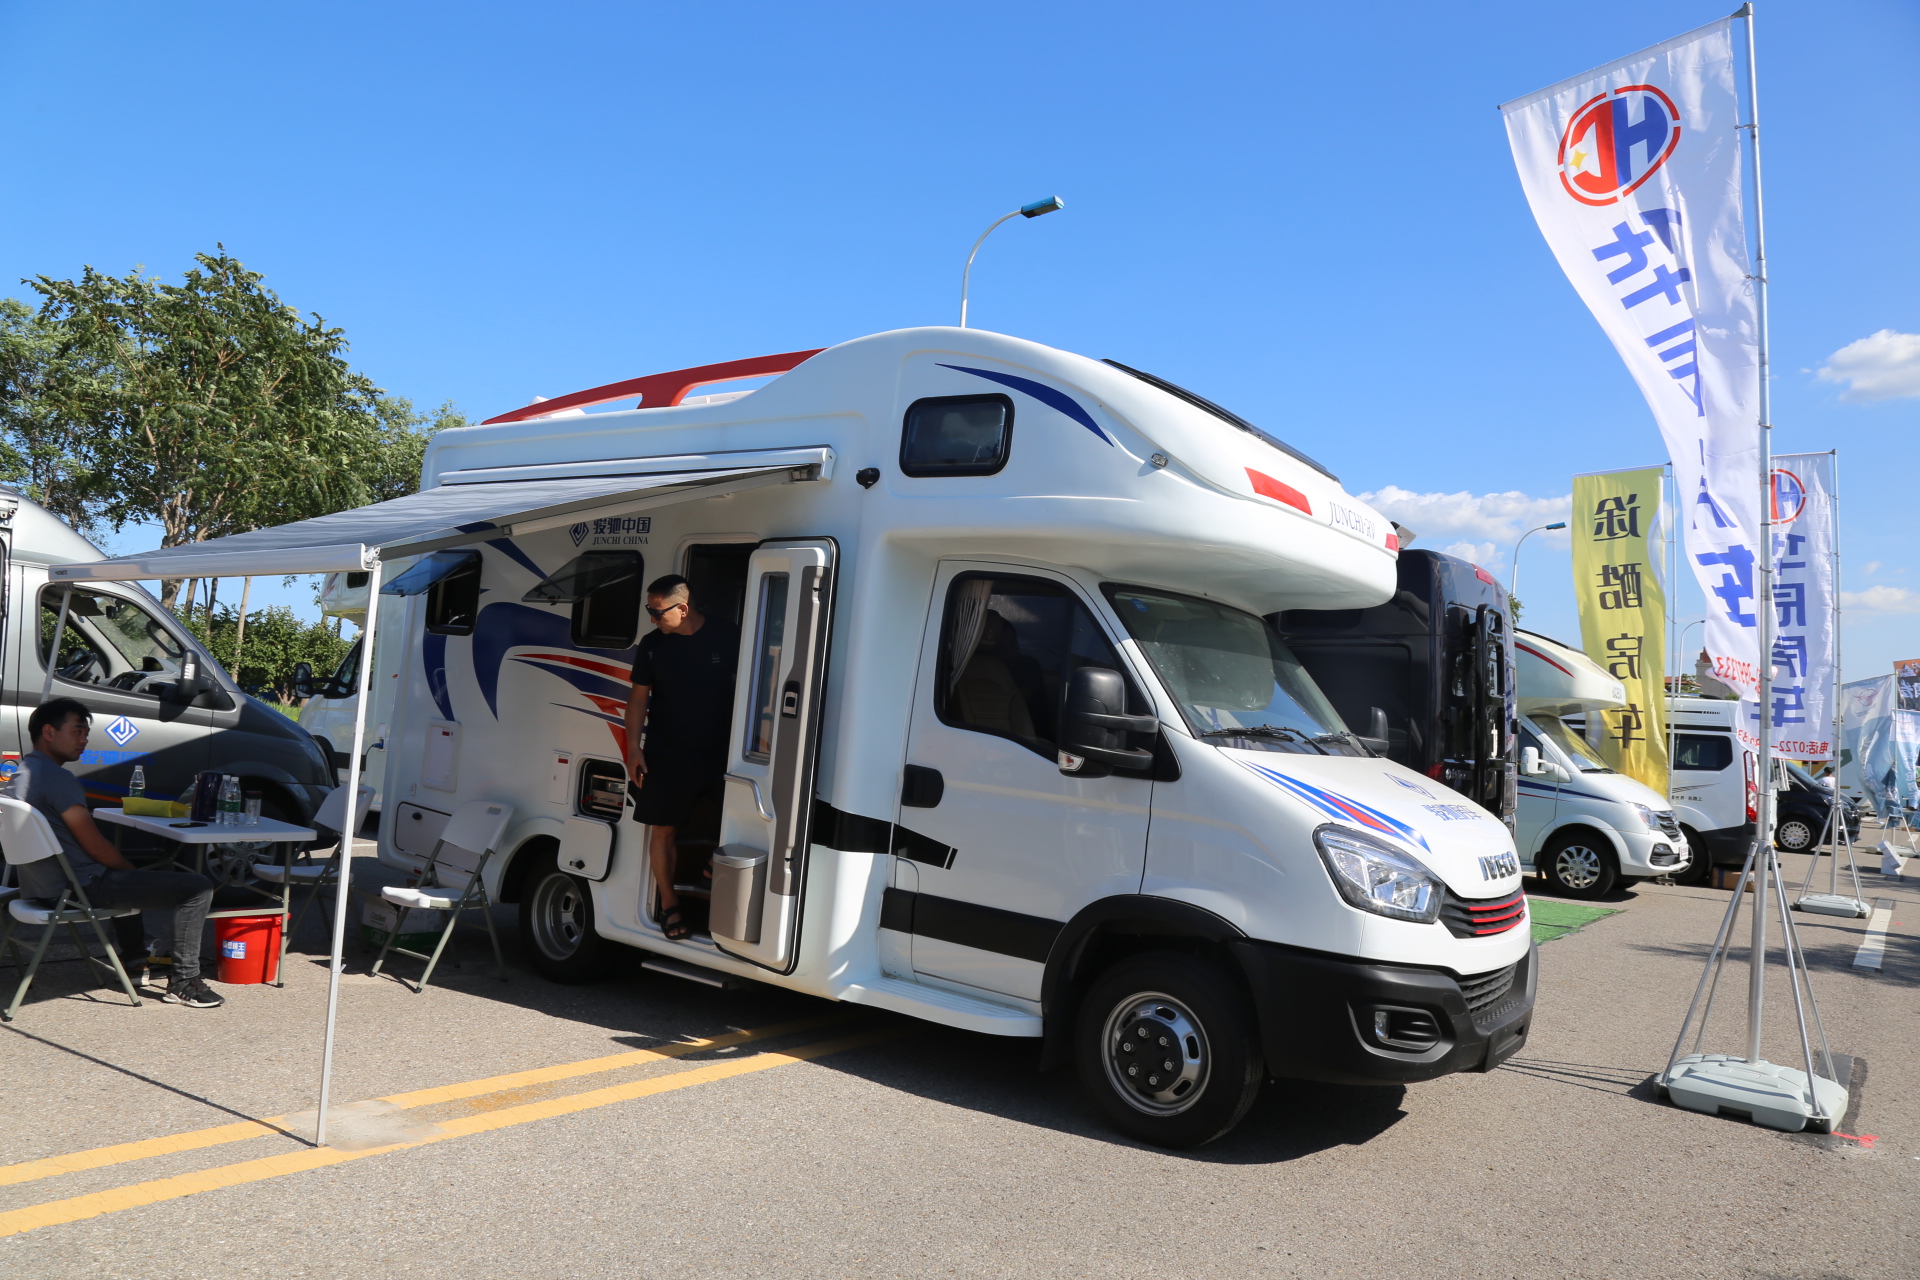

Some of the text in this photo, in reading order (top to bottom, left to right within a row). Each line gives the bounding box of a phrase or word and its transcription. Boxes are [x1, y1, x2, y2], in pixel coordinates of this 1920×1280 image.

[593, 517, 651, 534] 骏驰中国
[592, 535, 649, 546] JUNCHI CHINA
[1478, 850, 1518, 882] IVECO
